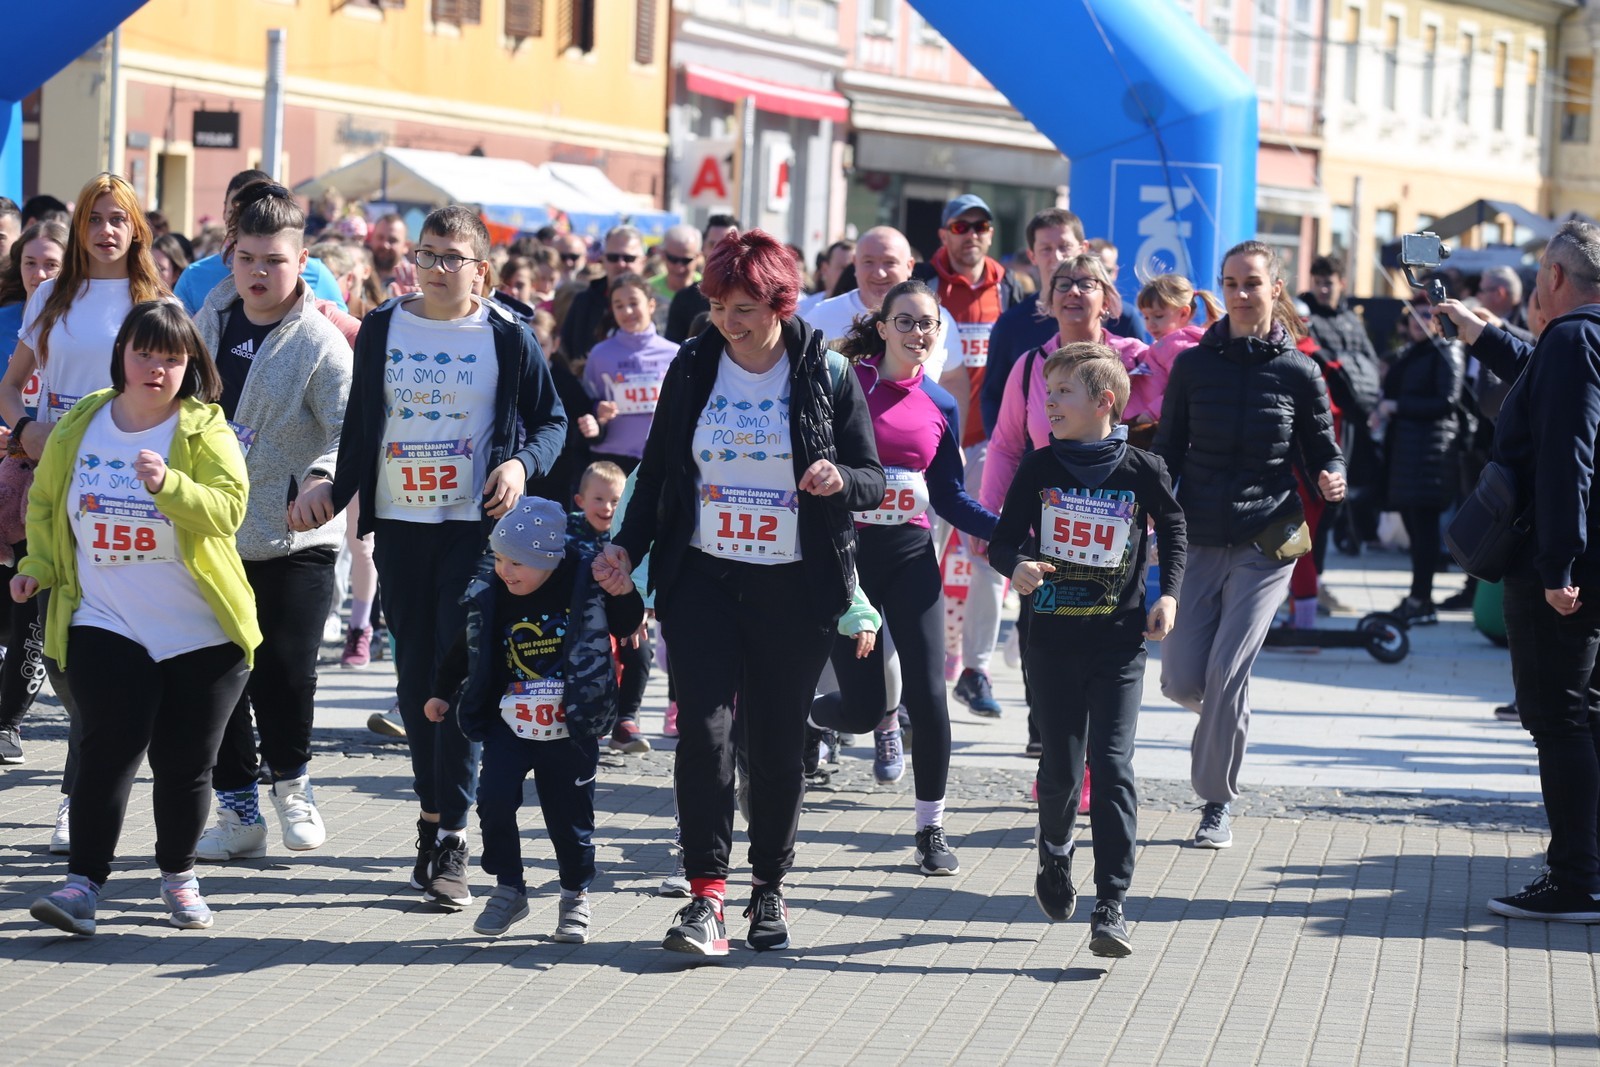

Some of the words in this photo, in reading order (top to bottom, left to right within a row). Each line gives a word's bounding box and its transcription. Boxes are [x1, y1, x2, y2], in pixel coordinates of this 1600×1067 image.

[690, 155, 726, 197] A
[386, 368, 403, 383] SVI
[413, 367, 446, 384] SMO
[456, 370, 473, 385] MI
[625, 386, 659, 403] 411
[706, 412, 727, 425] SVI
[737, 414, 770, 428] SMO
[779, 411, 790, 424] M
[424, 442, 454, 450] ČARAPAMA
[79, 472, 100, 488] SVI
[109, 473, 142, 490] SMO
[401, 465, 458, 491] 152
[722, 487, 748, 496] ŠARENIM
[747, 488, 780, 499] ČARAPAMA
[737, 496, 754, 504] CILJA
[1061, 493, 1085, 505] ŠARENIM
[1085, 497, 1116, 509] ČARAPAMA
[124, 499, 155, 511] ČARAPAMA
[1075, 505, 1091, 513] CILJA
[717, 511, 778, 542] 112
[1053, 516, 1115, 551] 554
[92, 522, 157, 552] 158
[517, 642, 532, 650] BUDI
[540, 646, 556, 654] COOL
